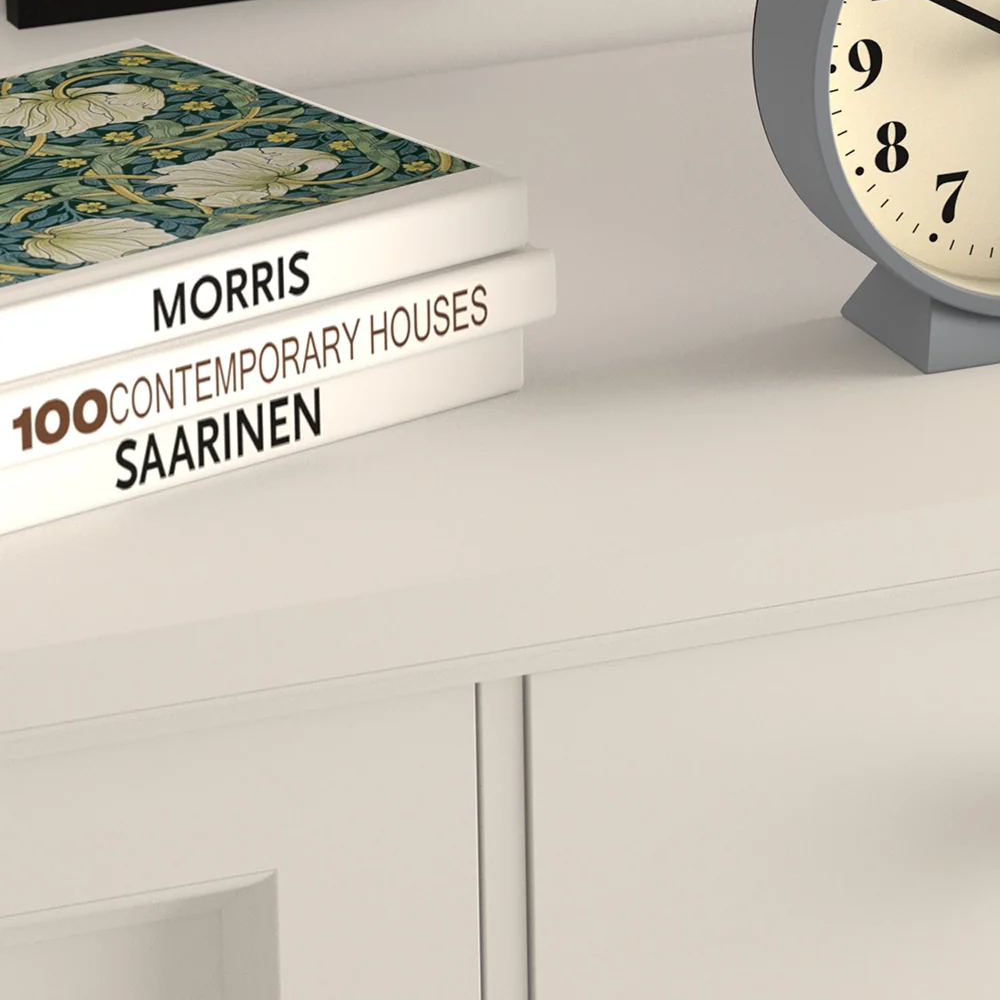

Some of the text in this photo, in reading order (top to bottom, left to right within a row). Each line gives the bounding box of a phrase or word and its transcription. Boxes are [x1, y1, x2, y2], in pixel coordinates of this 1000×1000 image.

[848, 38, 883, 92] 9
[874, 120, 910, 173] 8
[935, 170, 969, 224] 7
[152, 250, 310, 332] MORRIS
[370, 284, 488, 355] HOUSES
[115, 387, 321, 491] SAARINEN
